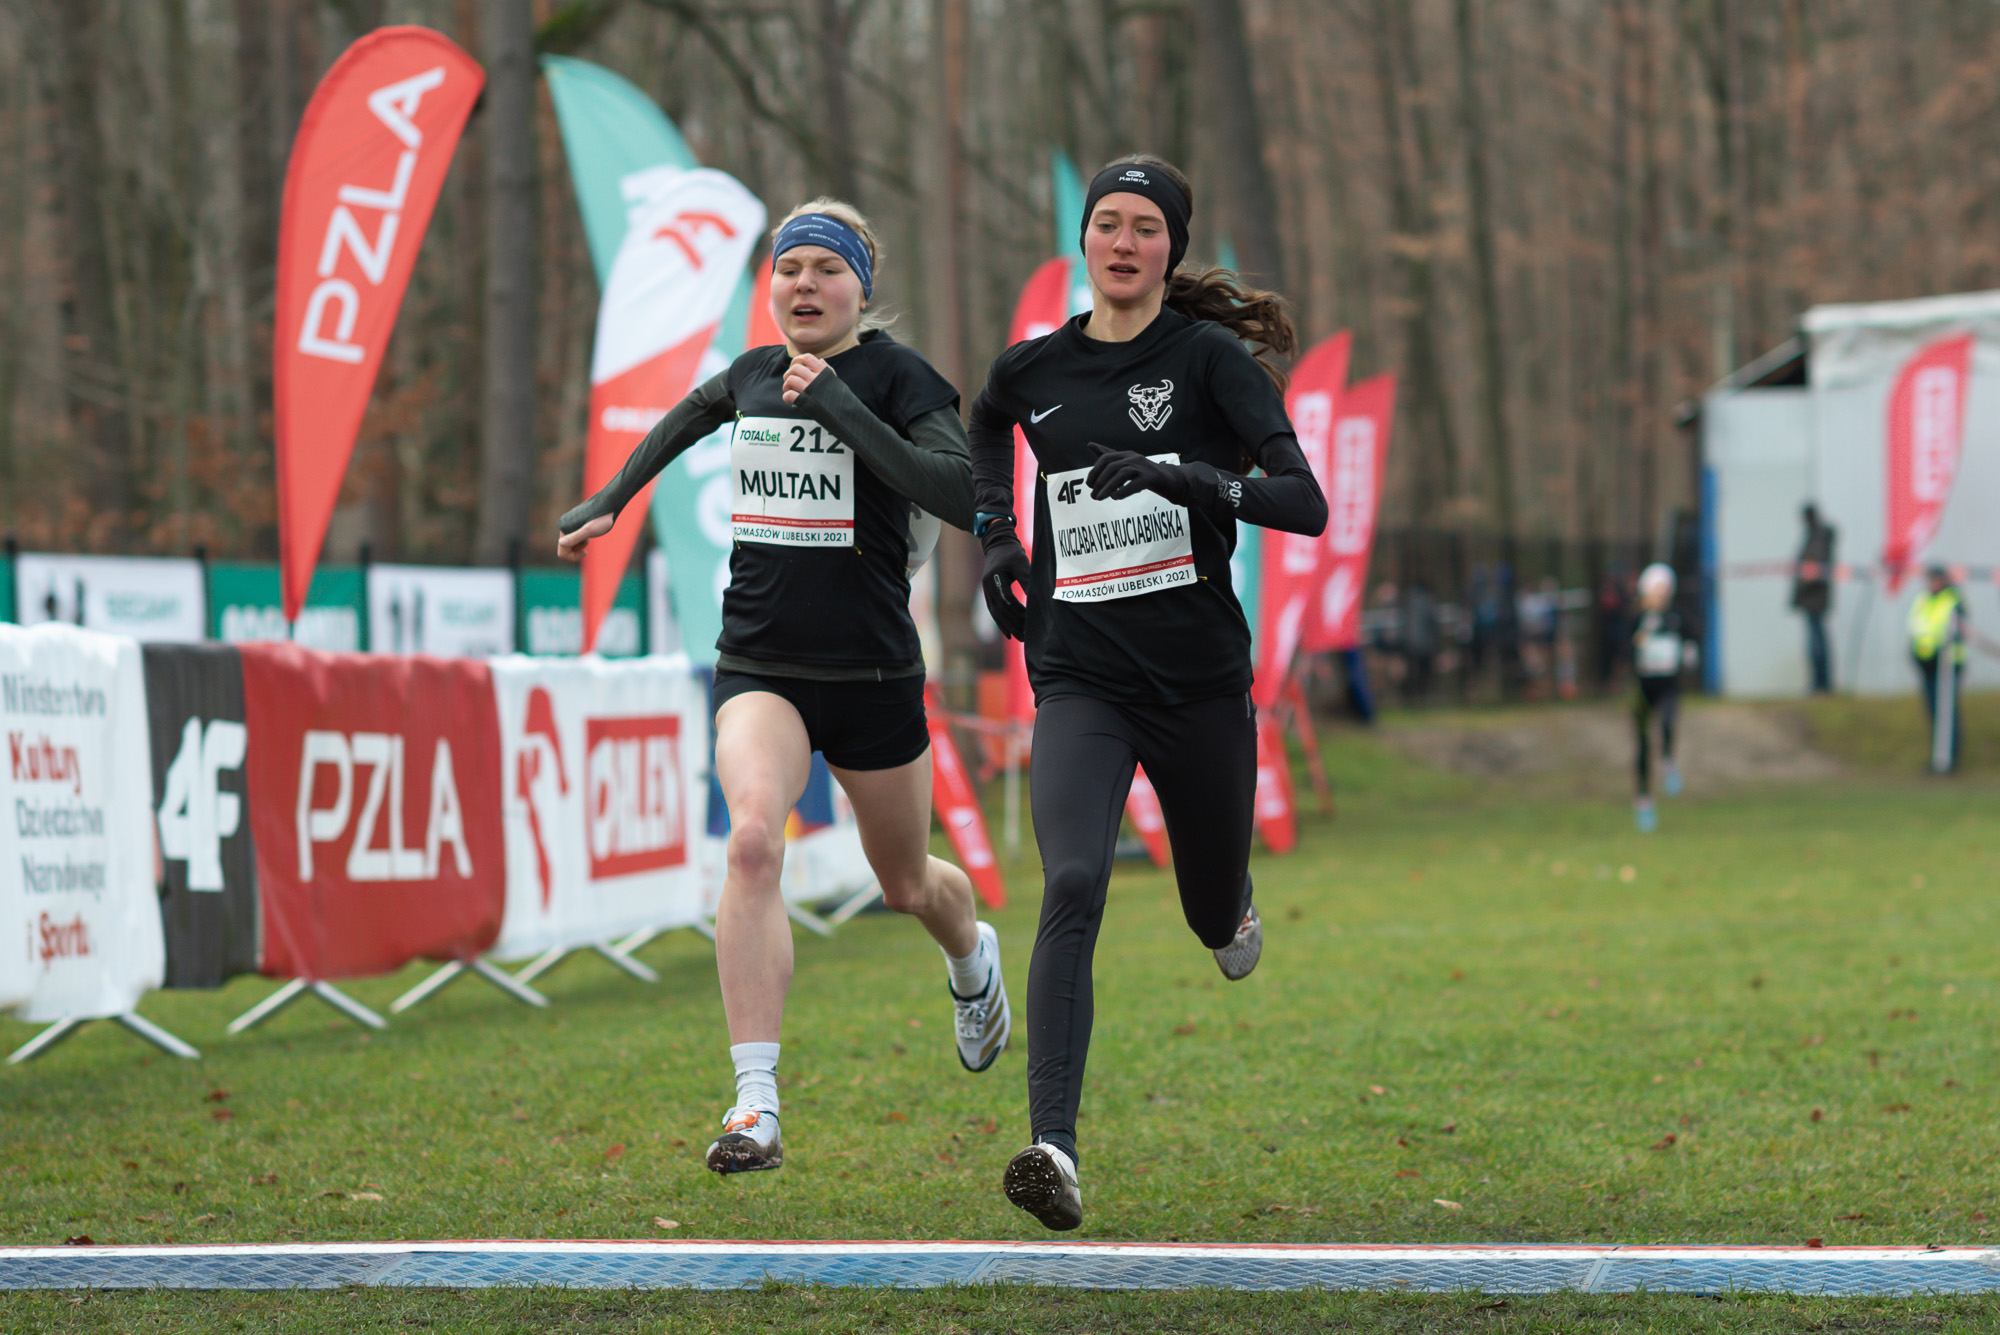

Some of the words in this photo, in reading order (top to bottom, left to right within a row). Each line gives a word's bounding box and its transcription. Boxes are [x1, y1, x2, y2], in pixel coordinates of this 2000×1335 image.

[297, 66, 446, 364] PZLA
[739, 429, 781, 443] TOTALbet
[740, 469, 841, 501] MULTAN
[1057, 478, 1085, 504] 4F
[733, 526, 780, 539] TOMASZÓW
[782, 531, 820, 541] LUBELSKI
[823, 532, 847, 541] 2021
[1058, 525, 1098, 558] KUCZABA
[1093, 521, 1115, 551] VEL
[1111, 506, 1184, 549] KUCIABIŃSKA
[1061, 584, 1115, 599] TOMASZÓW
[1117, 575, 1163, 592] LUBELSKI
[1166, 569, 1190, 582] 2021
[157, 716, 247, 892] 4F
[296, 730, 473, 883] PZLA
